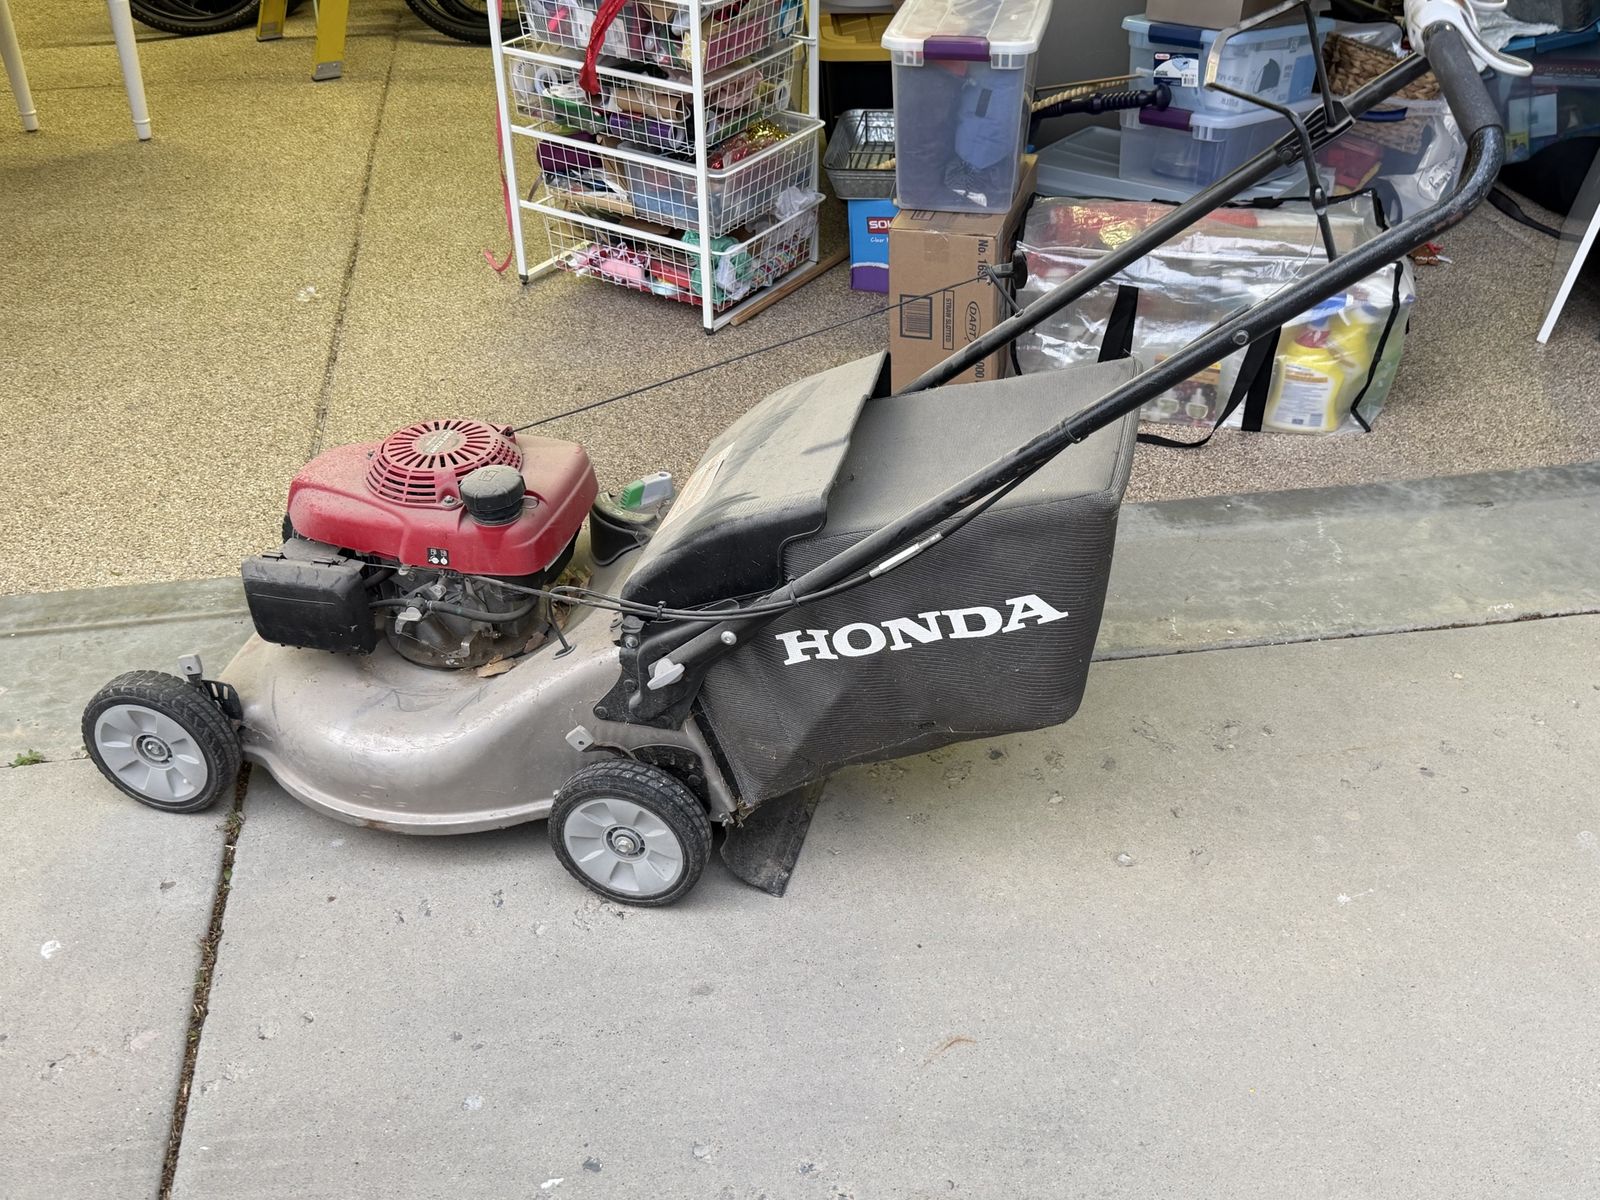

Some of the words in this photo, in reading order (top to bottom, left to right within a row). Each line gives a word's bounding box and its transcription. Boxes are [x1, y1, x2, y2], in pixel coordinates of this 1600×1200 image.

[978, 239, 988, 256] No.
[968, 306, 977, 338] DART
[775, 594, 1069, 666] HONDA
